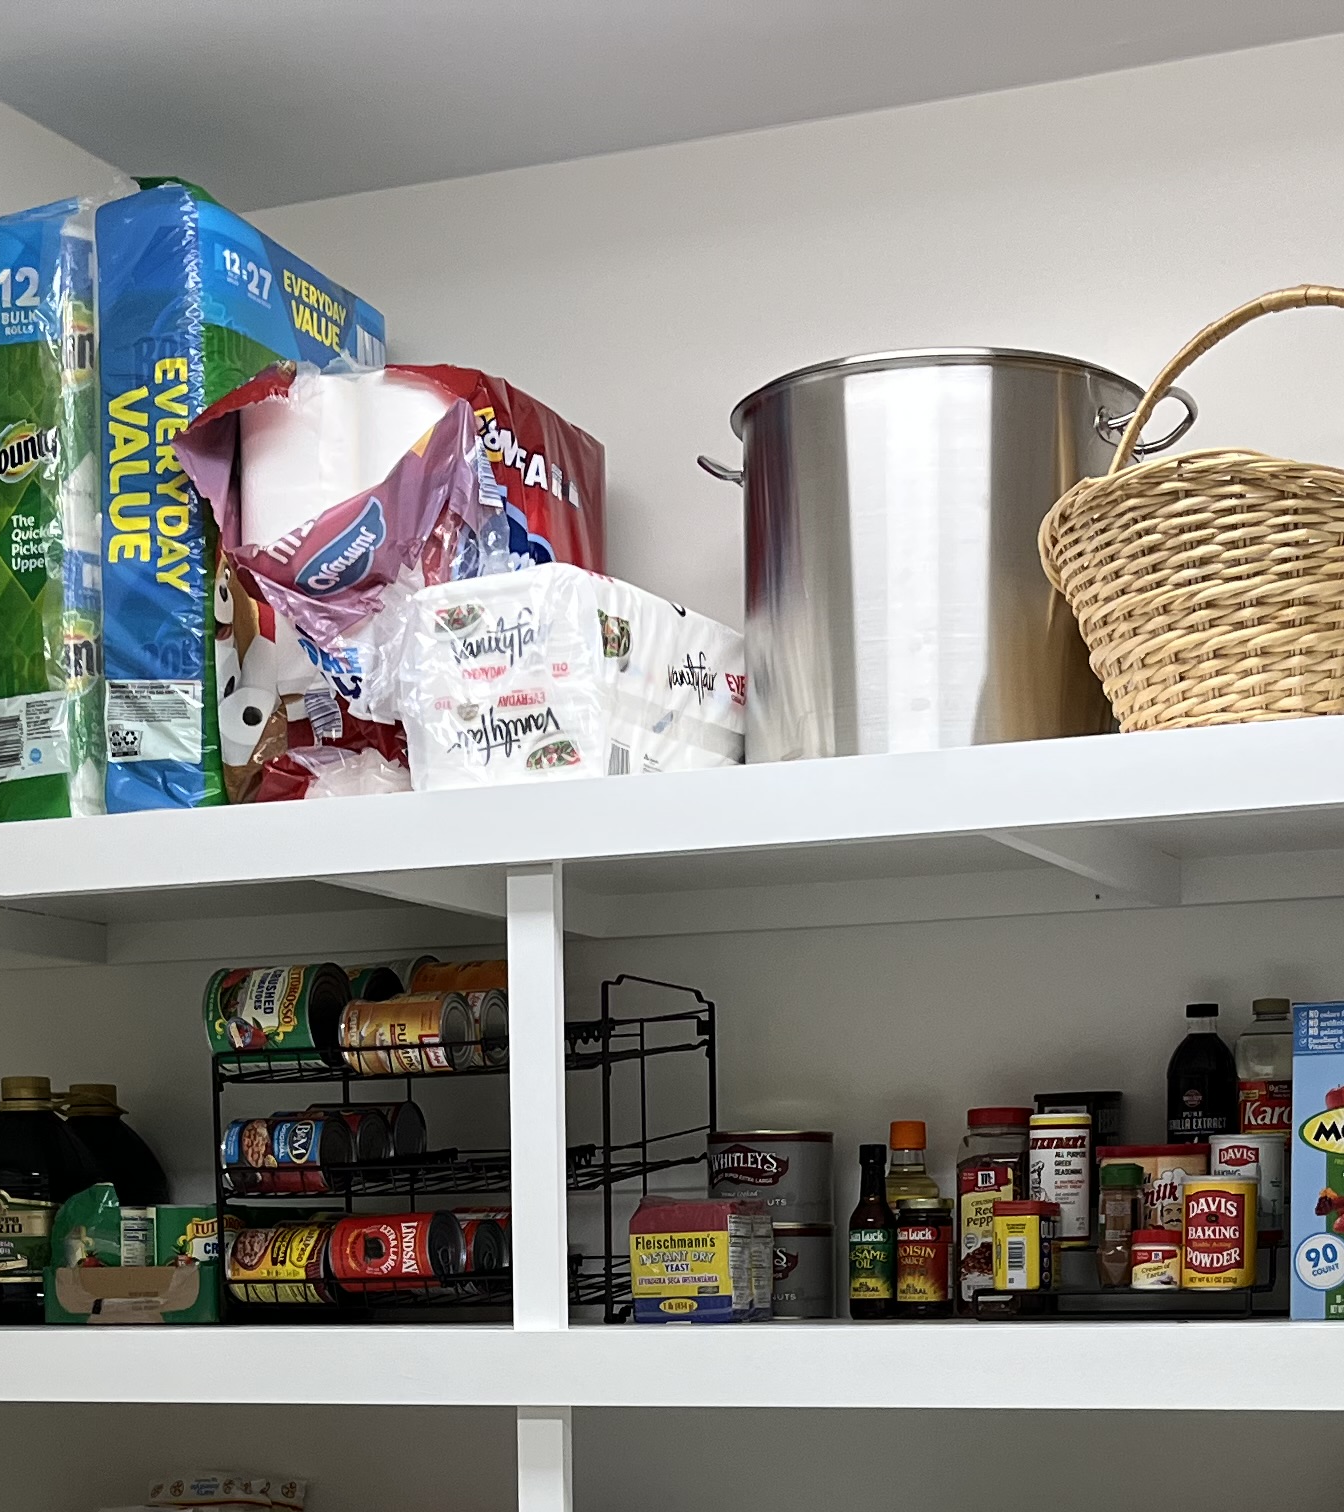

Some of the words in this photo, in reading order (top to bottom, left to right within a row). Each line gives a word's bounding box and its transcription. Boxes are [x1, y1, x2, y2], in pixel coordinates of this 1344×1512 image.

[283, 269, 347, 326] EVERYDAY
[1, 310, 38, 325] BULK
[5, 324, 34, 335] ROLLS
[291, 300, 341, 352] VALUE
[108, 385, 152, 563] VALUE
[155, 357, 191, 593] EVERYDAY
[11, 514, 35, 528] The
[1308, 1010, 1319, 1018] NO
[1308, 1019, 1319, 1027] NO
[1308, 1027, 1319, 1036] NO
[1192, 1116, 1227, 1130] EXTRACT
[711, 1152, 777, 1173] WHITLEY'S
[1220, 1147, 1257, 1163] DAVIS
[1188, 1196, 1238, 1219] DAVIS
[967, 1215, 993, 1228] Pepp
[861, 1230, 884, 1242] Luck
[909, 1227, 932, 1241] Luck
[1187, 1225, 1240, 1240] BAKING
[401, 1221, 419, 1275] LINDSAY
[635, 1233, 716, 1250] Fleischmann's
[639, 1250, 688, 1266] INSTANT
[690, 1252, 716, 1263] DRY
[855, 1258, 874, 1269] OIL
[901, 1256, 925, 1266] SAUCE
[1186, 1247, 1241, 1268] POWDER
[1306, 1243, 1338, 1269] 90
[665, 1263, 689, 1273] YEAST
[1311, 1263, 1340, 1277] COUNT
